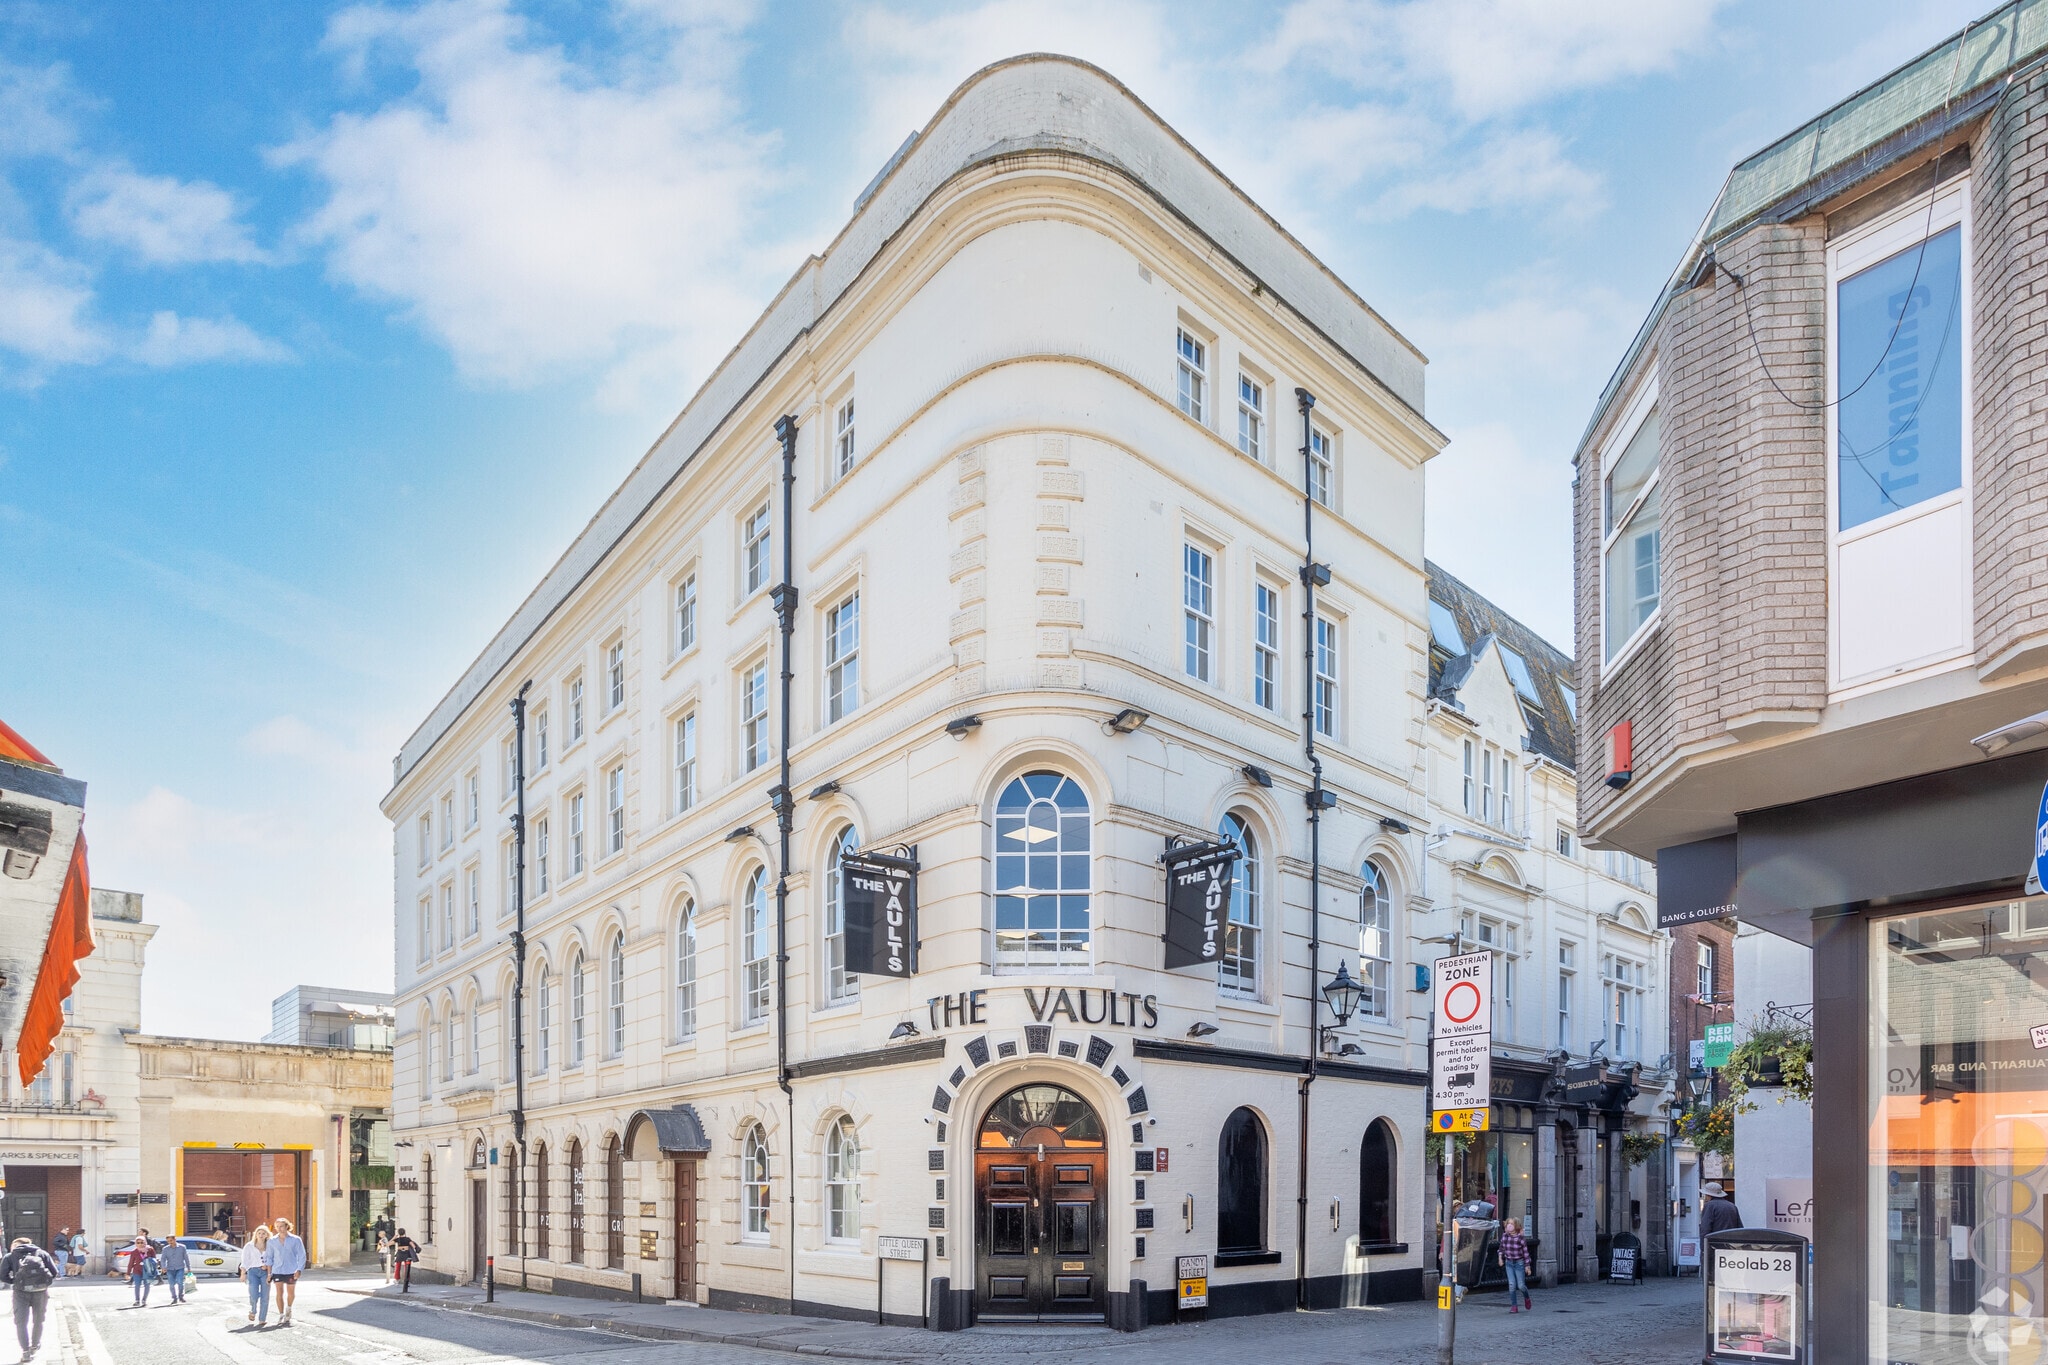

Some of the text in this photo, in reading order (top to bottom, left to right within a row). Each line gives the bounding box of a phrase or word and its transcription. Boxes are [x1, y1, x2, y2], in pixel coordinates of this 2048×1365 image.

[1878, 284, 1931, 505] Tanning
[1178, 862, 1225, 957] THE VAULTS
[1661, 903, 1738, 923] BANG & OLUFSEN
[852, 877, 904, 973] THE VAULTS
[1439, 954, 1488, 969] PEDESTRIAN
[1445, 965, 1480, 981] ZONE
[927, 987, 1158, 1031] THE VAULTS
[1441, 1024, 1483, 1035] No Vehicles
[1708, 1026, 1732, 1036] RED
[1449, 1039, 1474, 1048] Except
[1460, 1045, 1488, 1055] holders
[1448, 1054, 1474, 1064] and for
[1443, 1062, 1480, 1072] loading by
[1887, 1067, 1921, 1088] oy
[1490, 1079, 1514, 1095] EYS
[1567, 1079, 1600, 1090] SOBEYS
[1435, 1091, 1453, 1099] 4.30
[1453, 1097, 1475, 1106] 10.30
[1459, 1112, 1468, 1120] At
[35, 1152, 80, 1160] SPENCER
[880, 1238, 923, 1249] LITTLE QUEEN
[890, 1249, 911, 1258] STREET
[1612, 1248, 1635, 1259] VINTAGE
[1181, 1258, 1205, 1267] GANDY
[1719, 1256, 1792, 1272] Beolab 28
[1180, 1268, 1205, 1278] STREET
